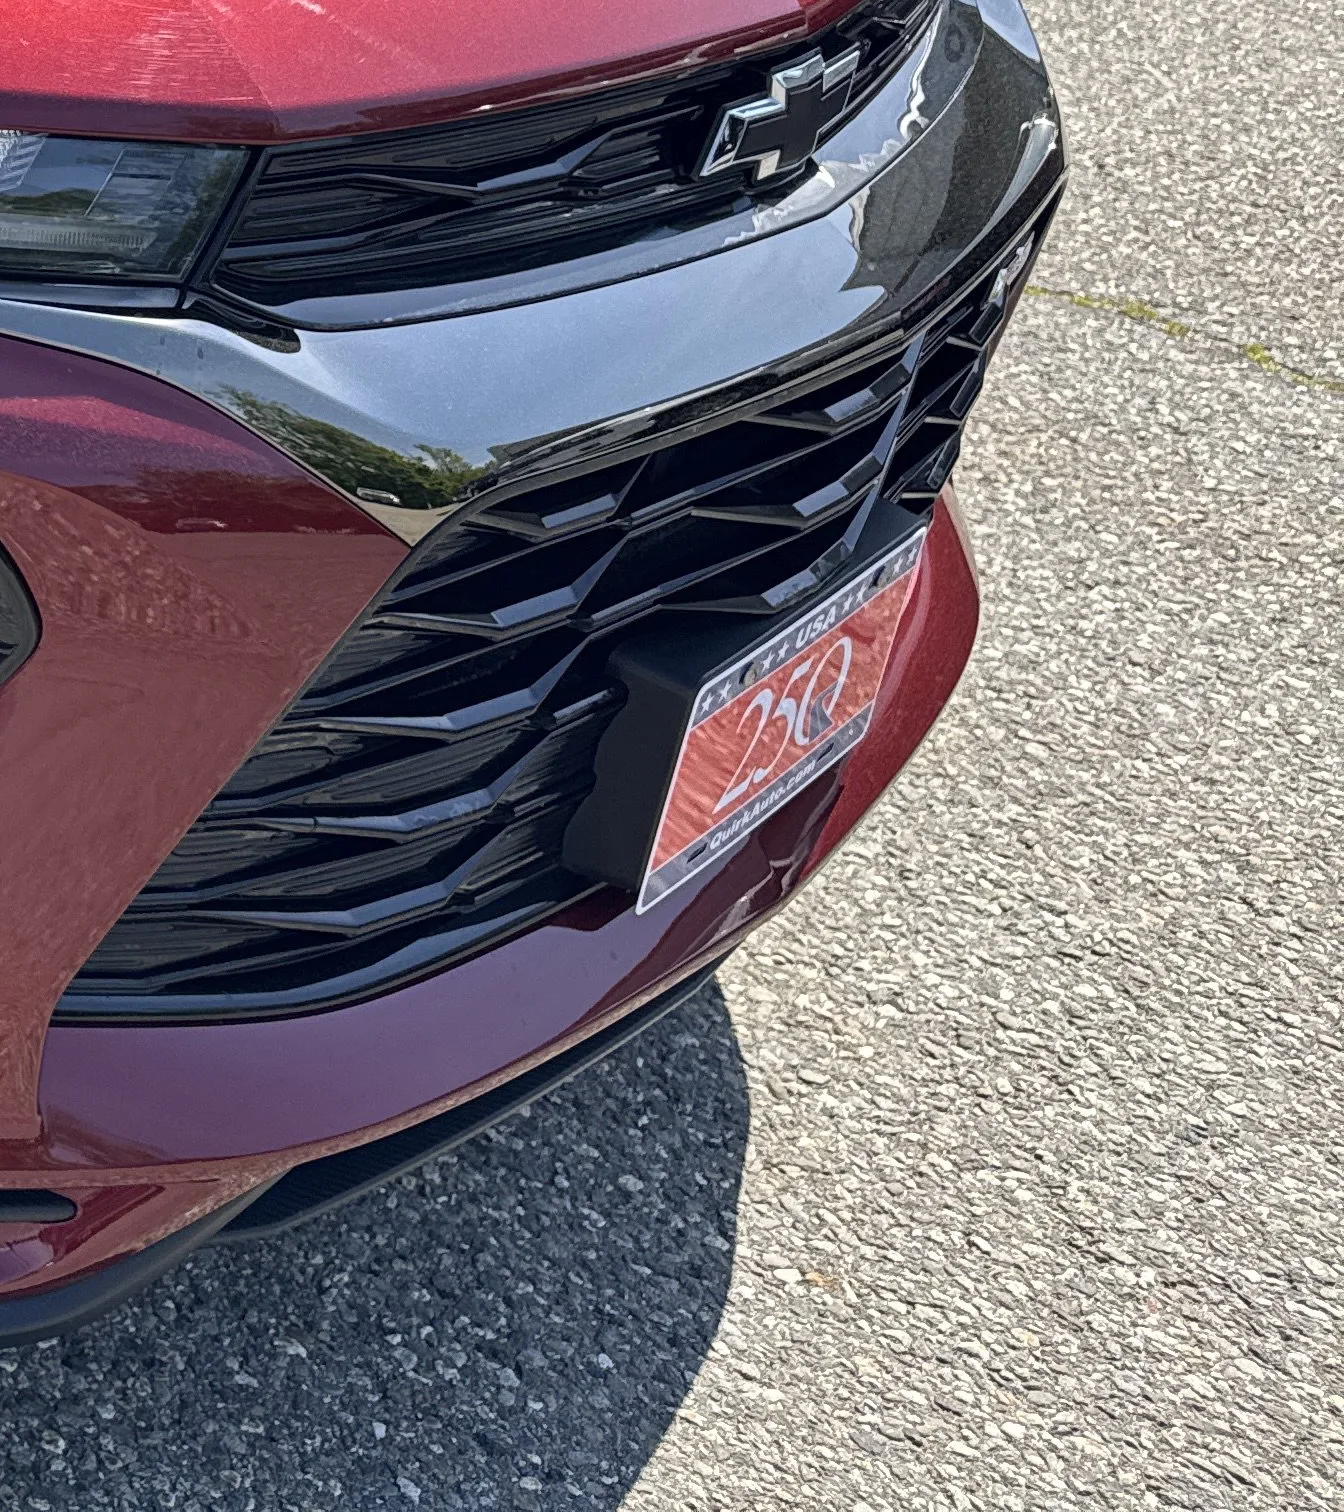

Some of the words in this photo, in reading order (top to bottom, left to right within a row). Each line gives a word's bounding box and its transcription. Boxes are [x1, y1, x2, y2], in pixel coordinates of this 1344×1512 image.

[795, 605, 837, 650] USA
[712, 636, 853, 815] 250
[709, 758, 816, 851] QuirkAuto.com
